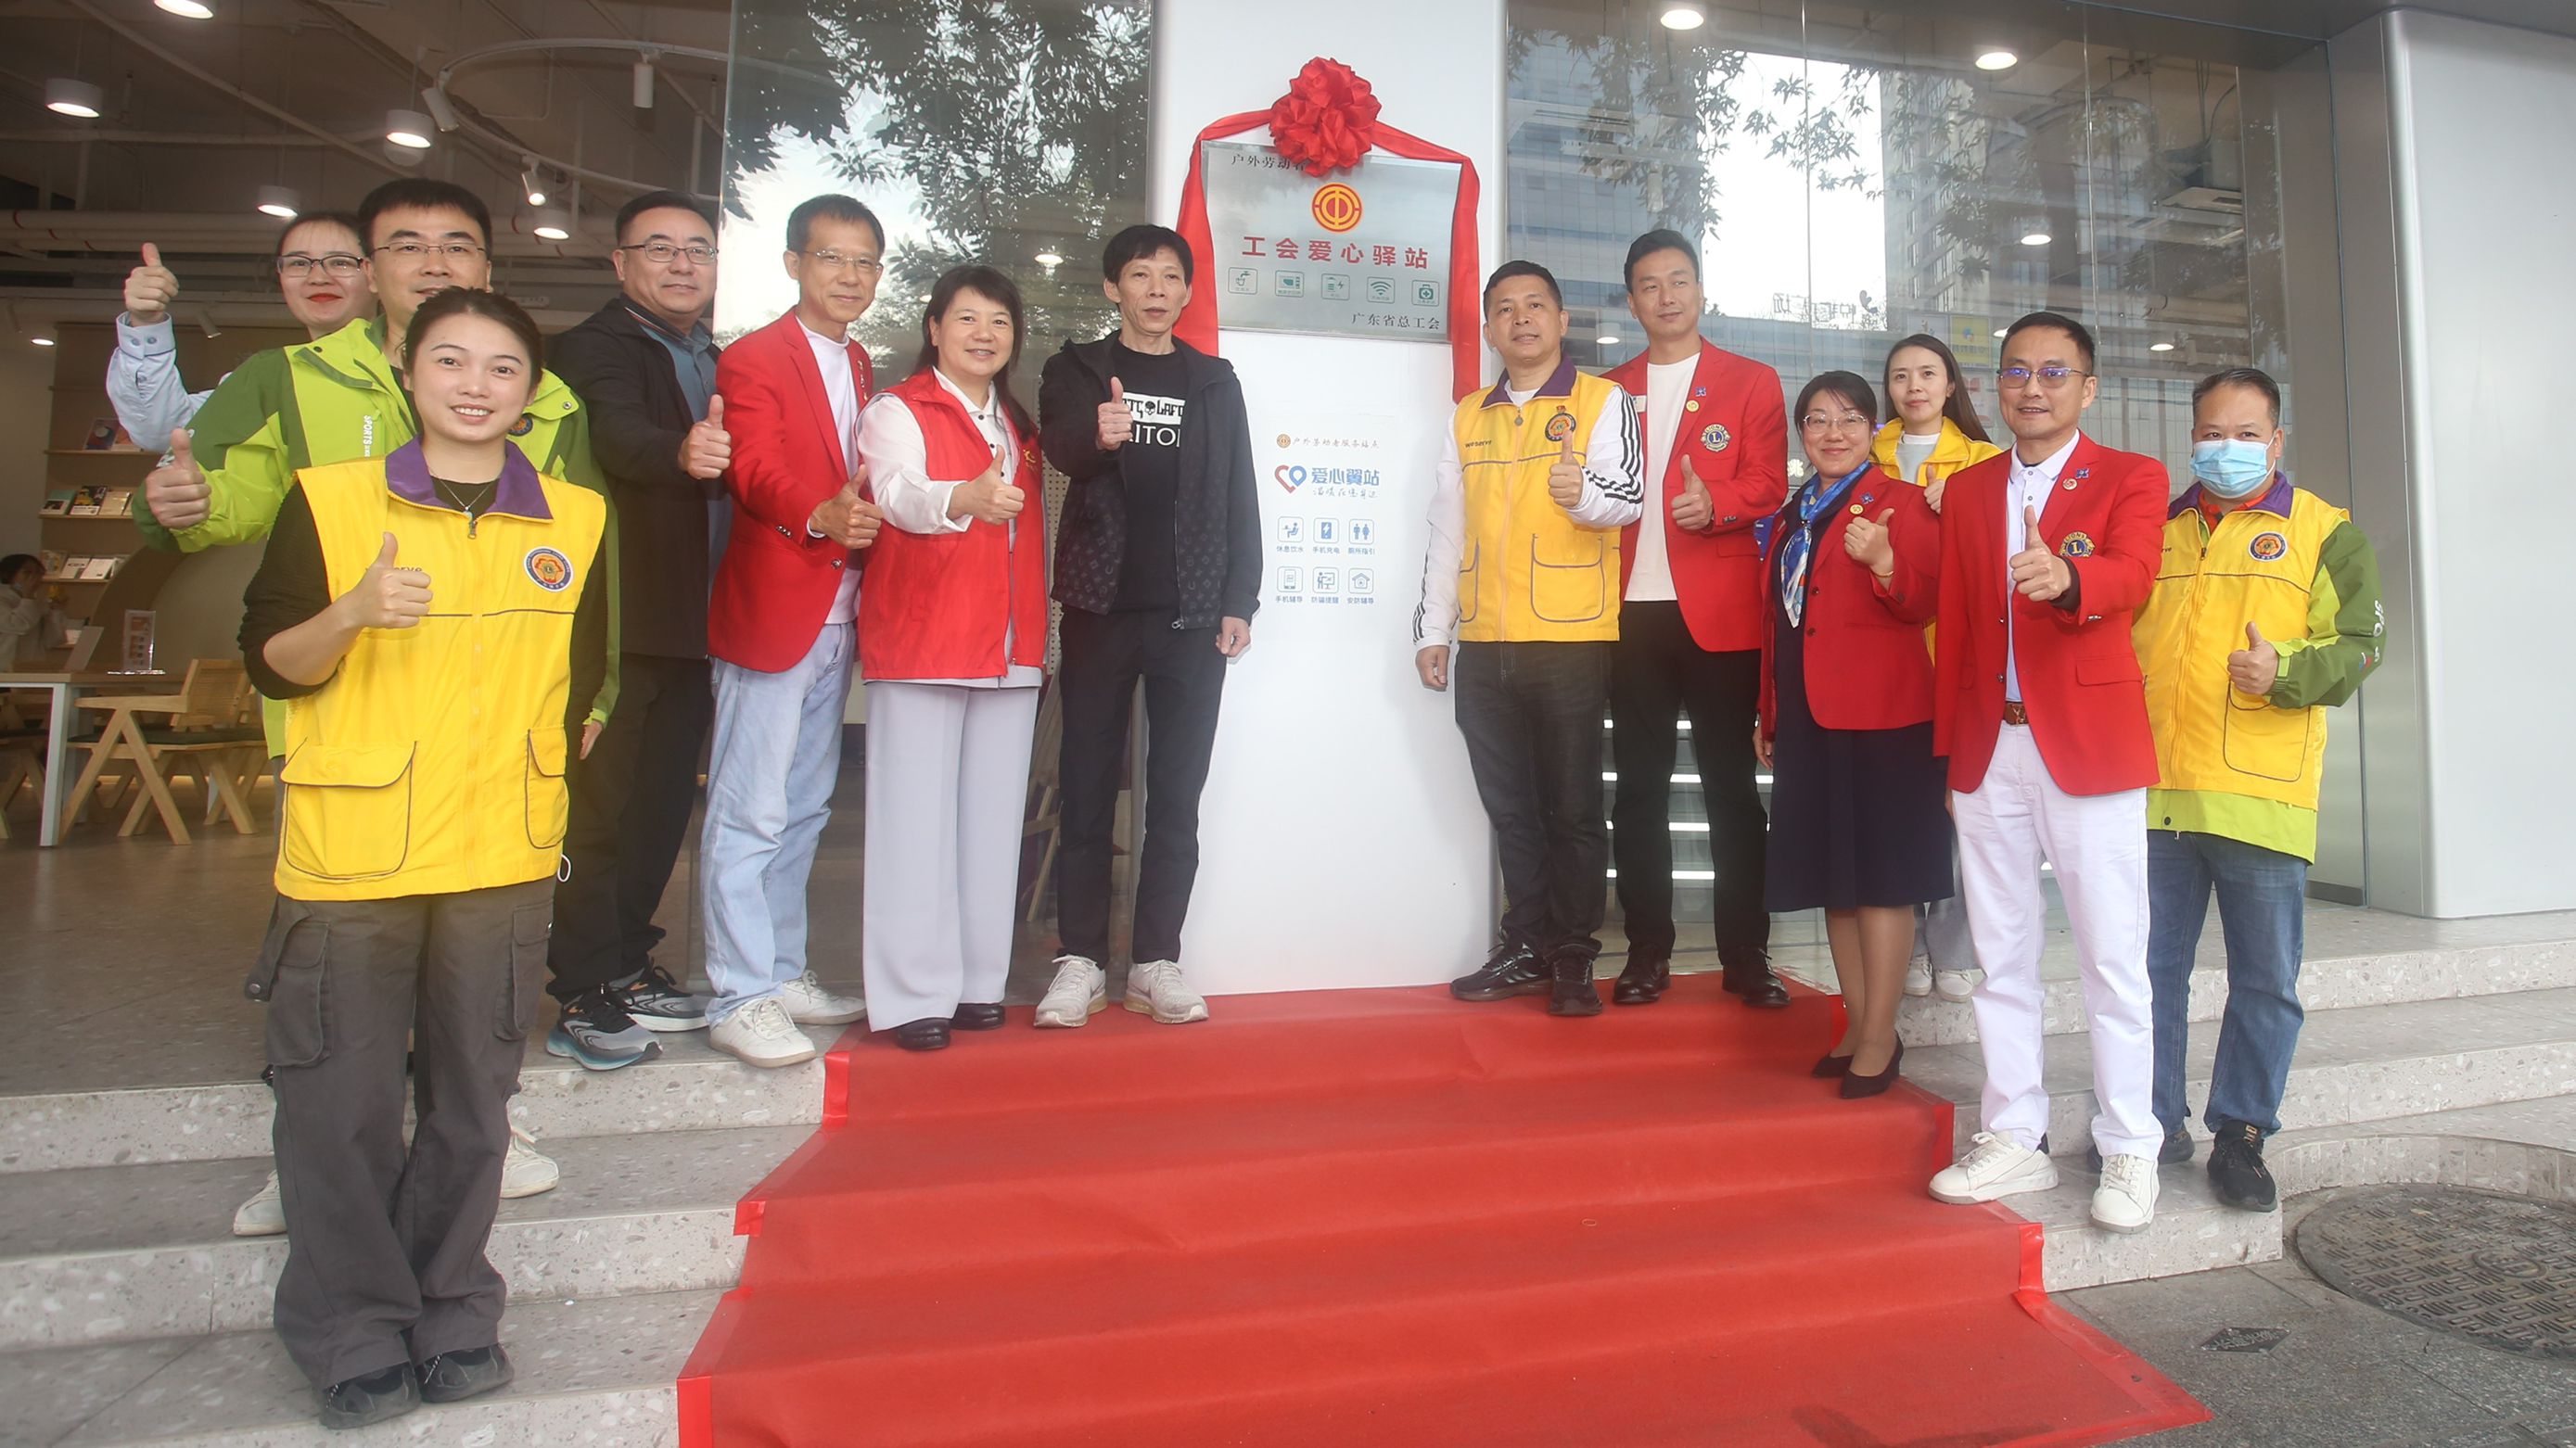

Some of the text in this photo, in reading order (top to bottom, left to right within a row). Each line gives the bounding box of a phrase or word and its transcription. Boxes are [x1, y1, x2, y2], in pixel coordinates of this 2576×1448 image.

[1242, 236, 1428, 270] 工会爱心驿站
[1351, 312, 1440, 330] 广东省总工会
[363, 414, 373, 445] SPORTS
[1129, 424, 1181, 448] ITO
[1712, 432, 1721, 443] L
[1311, 467, 1380, 486] 爱心翼站
[2071, 542, 2083, 554] L
